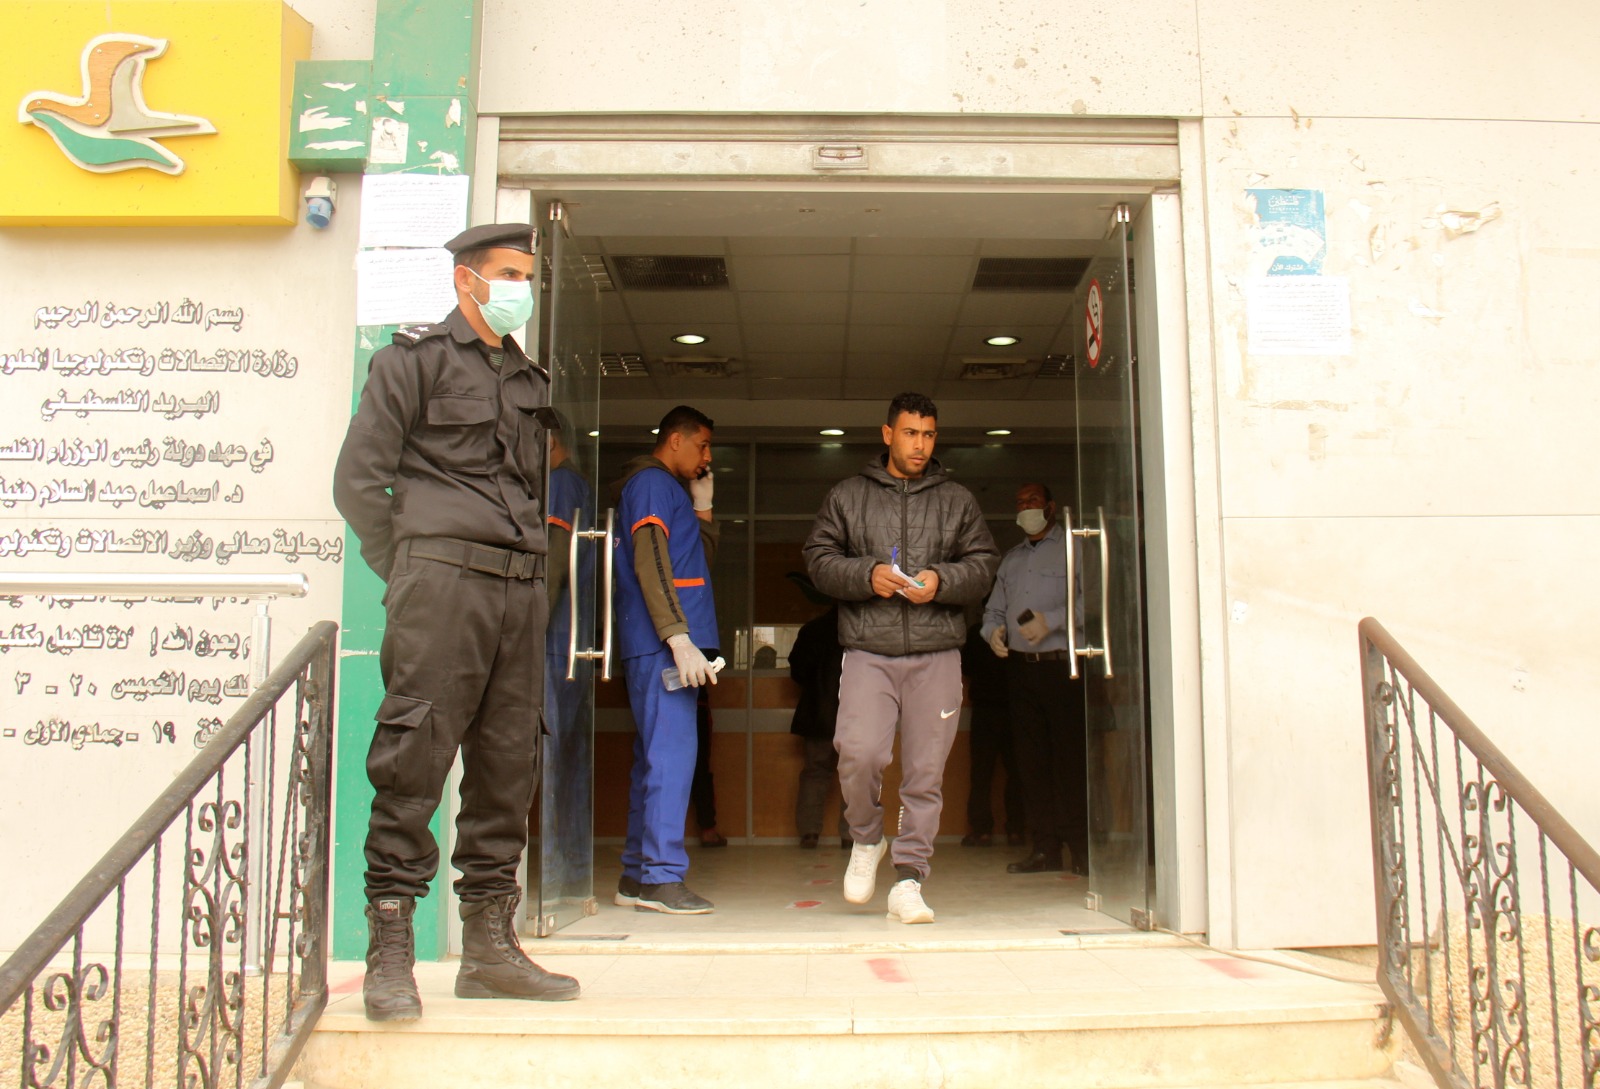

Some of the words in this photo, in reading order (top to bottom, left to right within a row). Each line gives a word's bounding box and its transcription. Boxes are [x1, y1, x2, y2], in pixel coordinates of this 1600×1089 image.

[34, 300, 99, 330] الرحيم
[100, 301, 169, 329] الرحمن
[171, 297, 203, 325] الله
[205, 307, 244, 332] بسم
[52, 347, 155, 377] وتكنولوجيا
[158, 348, 250, 373] الاتصالات
[252, 349, 298, 378] وزارة
[41, 388, 150, 422] الفلسطيني
[152, 390, 220, 420] البريد
[46, 437, 108, 467] الوزراء
[110, 438, 160, 468] رئيس
[162, 436, 206, 467] دولة
[208, 441, 248, 466] عهد
[249, 437, 274, 473] في
[39, 478, 96, 508] السلام
[98, 481, 137, 509] عبد
[139, 479, 219, 509] اسماعيل
[224, 484, 244, 503] د.
[75, 528, 168, 555] الاتصالات
[169, 530, 213, 561] وزير
[215, 530, 271, 565] معالي
[273, 528, 343, 564] برعاية
[46, 624, 105, 656] تأهيل
[195, 629, 240, 660] بعون
[14, 670, 31, 695] ٣
[45, 685, 58, 694] -
[111, 669, 185, 702] الخميس
[187, 677, 222, 706] يوم
[126, 732, 139, 742] -
[152, 720, 176, 744] ١٩
